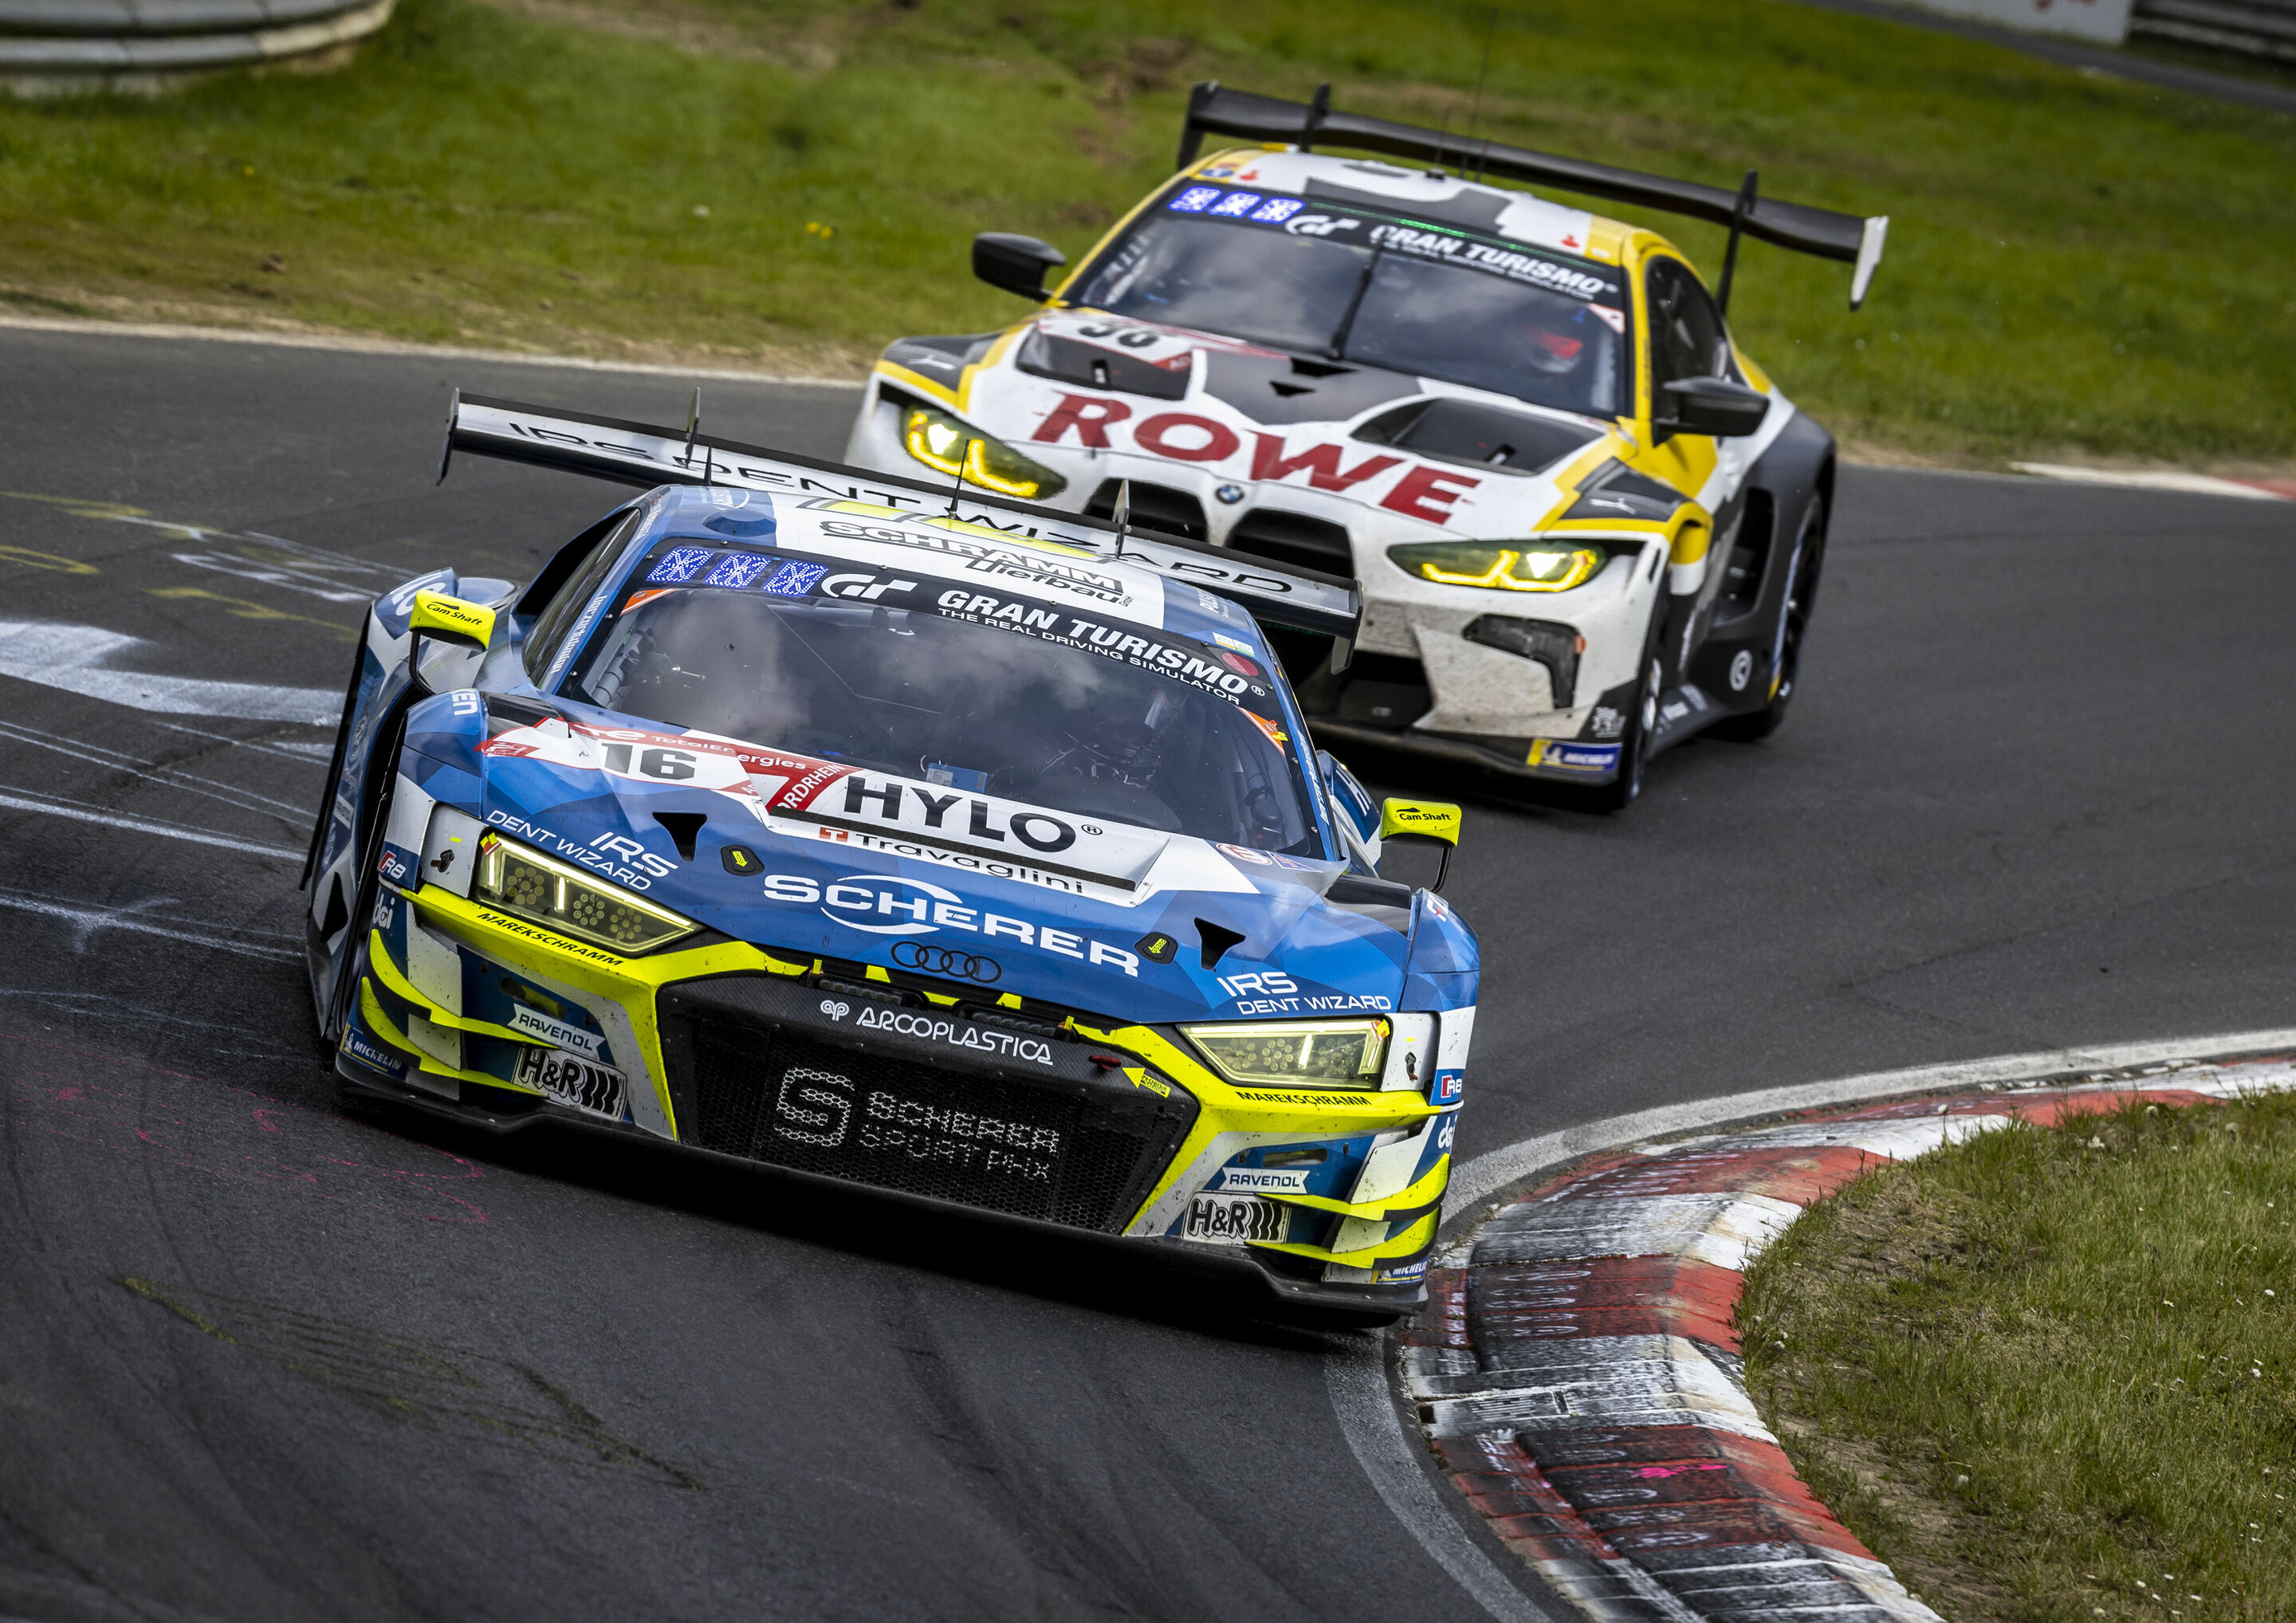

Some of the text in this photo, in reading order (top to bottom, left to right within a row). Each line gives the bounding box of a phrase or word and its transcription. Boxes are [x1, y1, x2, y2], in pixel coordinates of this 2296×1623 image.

[1370, 225, 1464, 254] GRAN
[1032, 390, 1481, 525] ROWE
[673, 456, 922, 508] DENT
[939, 505, 1292, 594] WIZARD
[820, 521, 1124, 593] SCHRAMM
[821, 573, 918, 599] GT
[965, 558, 1123, 604] Tiefbau
[427, 603, 482, 626] Cam Shaft
[938, 589, 1060, 631] GRAN
[938, 607, 1240, 705] THE REAL DRIVING SIMULATOR
[601, 742, 697, 780] 16
[380, 854, 407, 879] R8
[486, 810, 651, 890] DENT WIZARD
[589, 831, 678, 878] IRS
[855, 832, 1083, 894] Travaglini
[478, 913, 624, 966] MAREKSCHRAMM
[764, 874, 1139, 977] SCHERER
[1217, 972, 1298, 996] IRS
[1237, 996, 1392, 1015] DENT WIZARD
[518, 1013, 593, 1051] RAVENOL
[856, 1007, 1053, 1066] ARCOPLASTICA
[353, 1040, 402, 1071] MICHELIN
[519, 1047, 583, 1099] H&R
[1236, 1091, 1372, 1106] MAREKSCHRAMM
[1444, 1077, 1462, 1096] R8
[867, 1091, 1060, 1153] SCHERER
[860, 1123, 981, 1166] SPORT
[1229, 1173, 1300, 1188] RAVENOL
[1188, 1199, 1248, 1236] H&R
